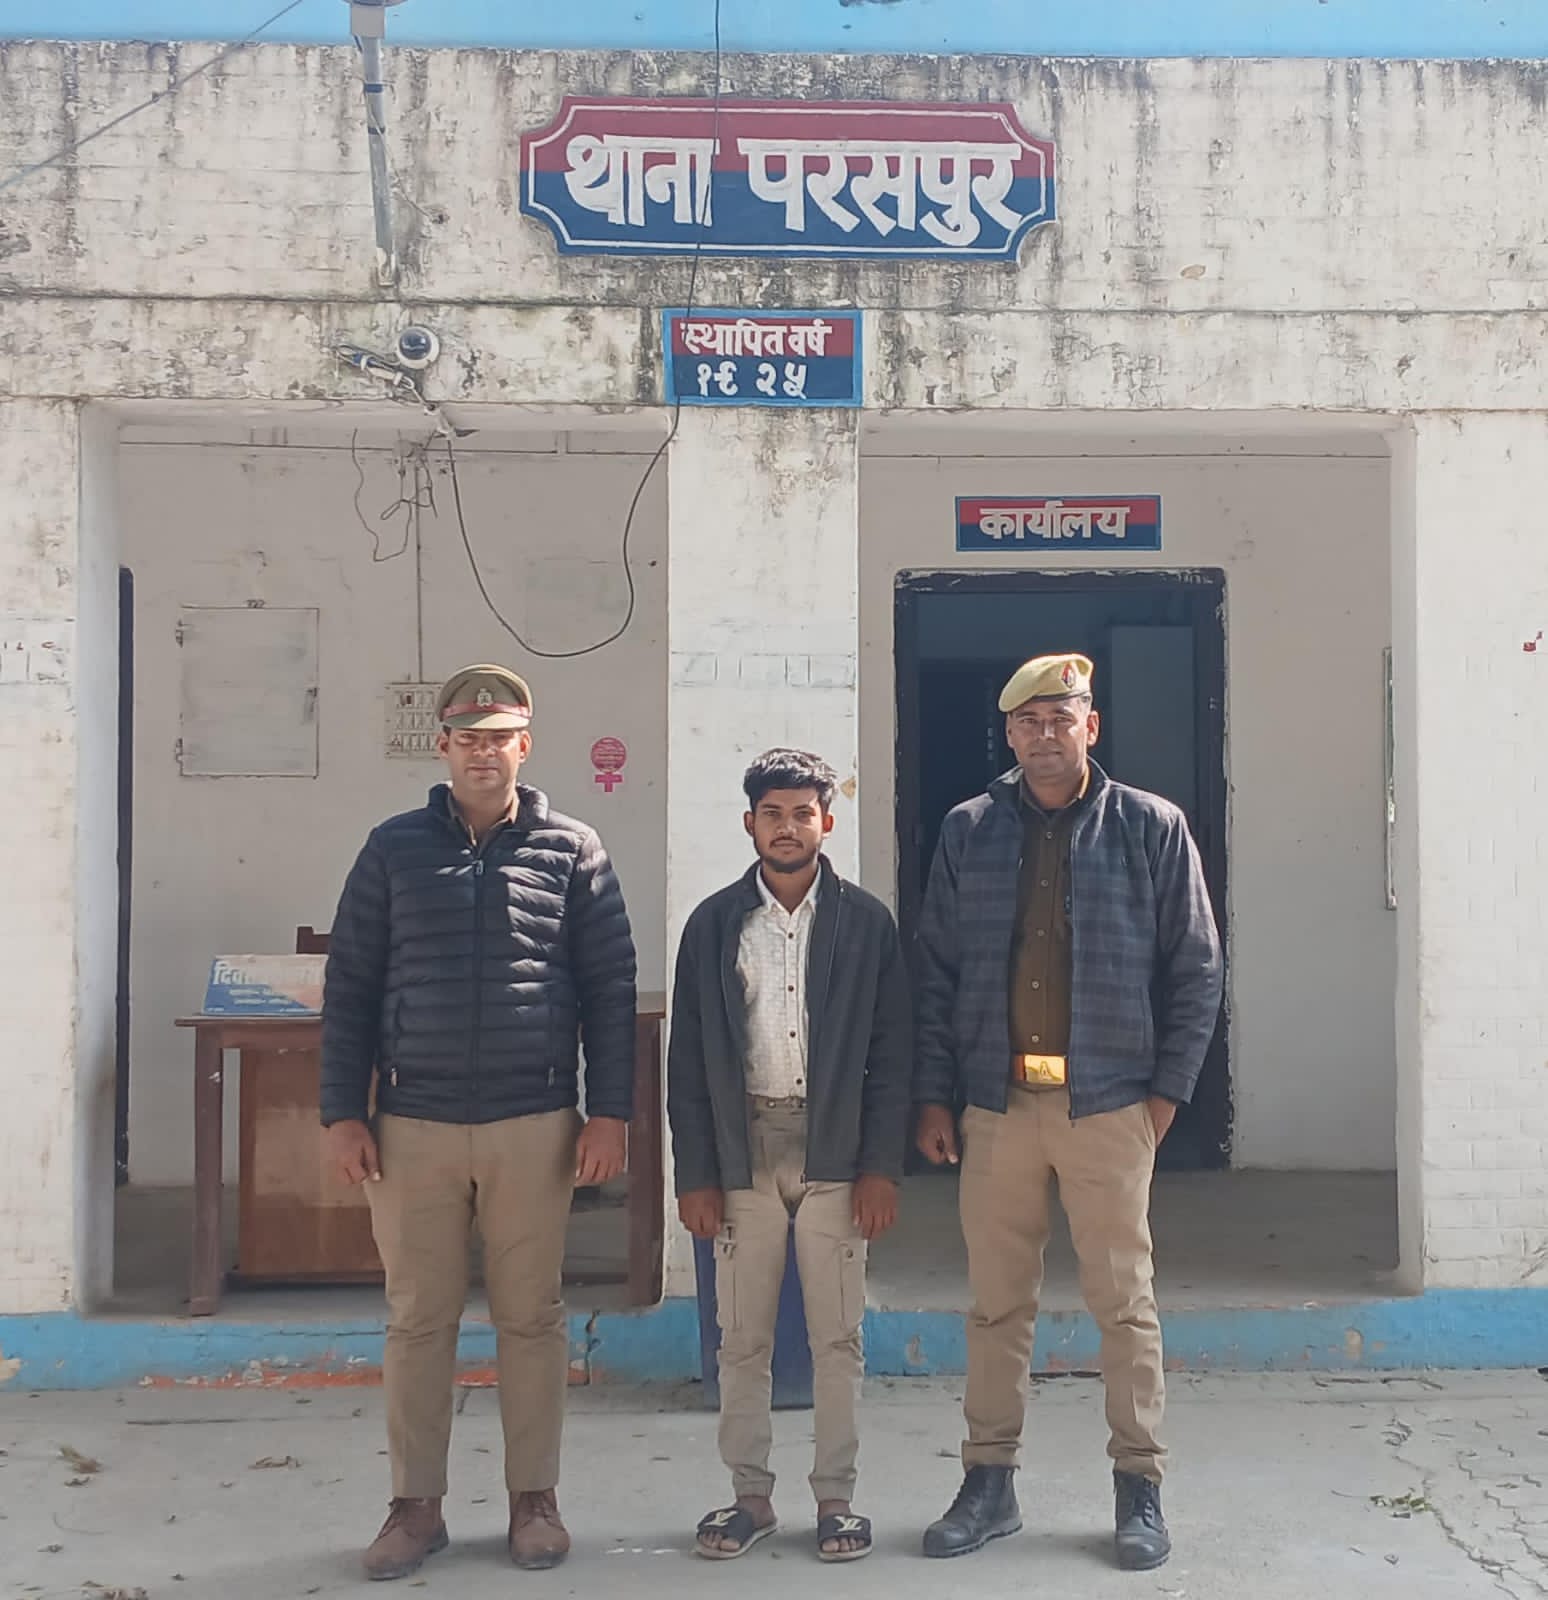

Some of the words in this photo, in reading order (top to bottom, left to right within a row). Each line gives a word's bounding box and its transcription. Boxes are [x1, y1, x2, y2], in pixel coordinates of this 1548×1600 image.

[562, 133, 720, 227] थाना
[736, 137, 1022, 247] परसपुर
[680, 318, 787, 357] स्थापित
[788, 318, 832, 357] वर्ष
[979, 500, 1130, 540] कार्यालय
